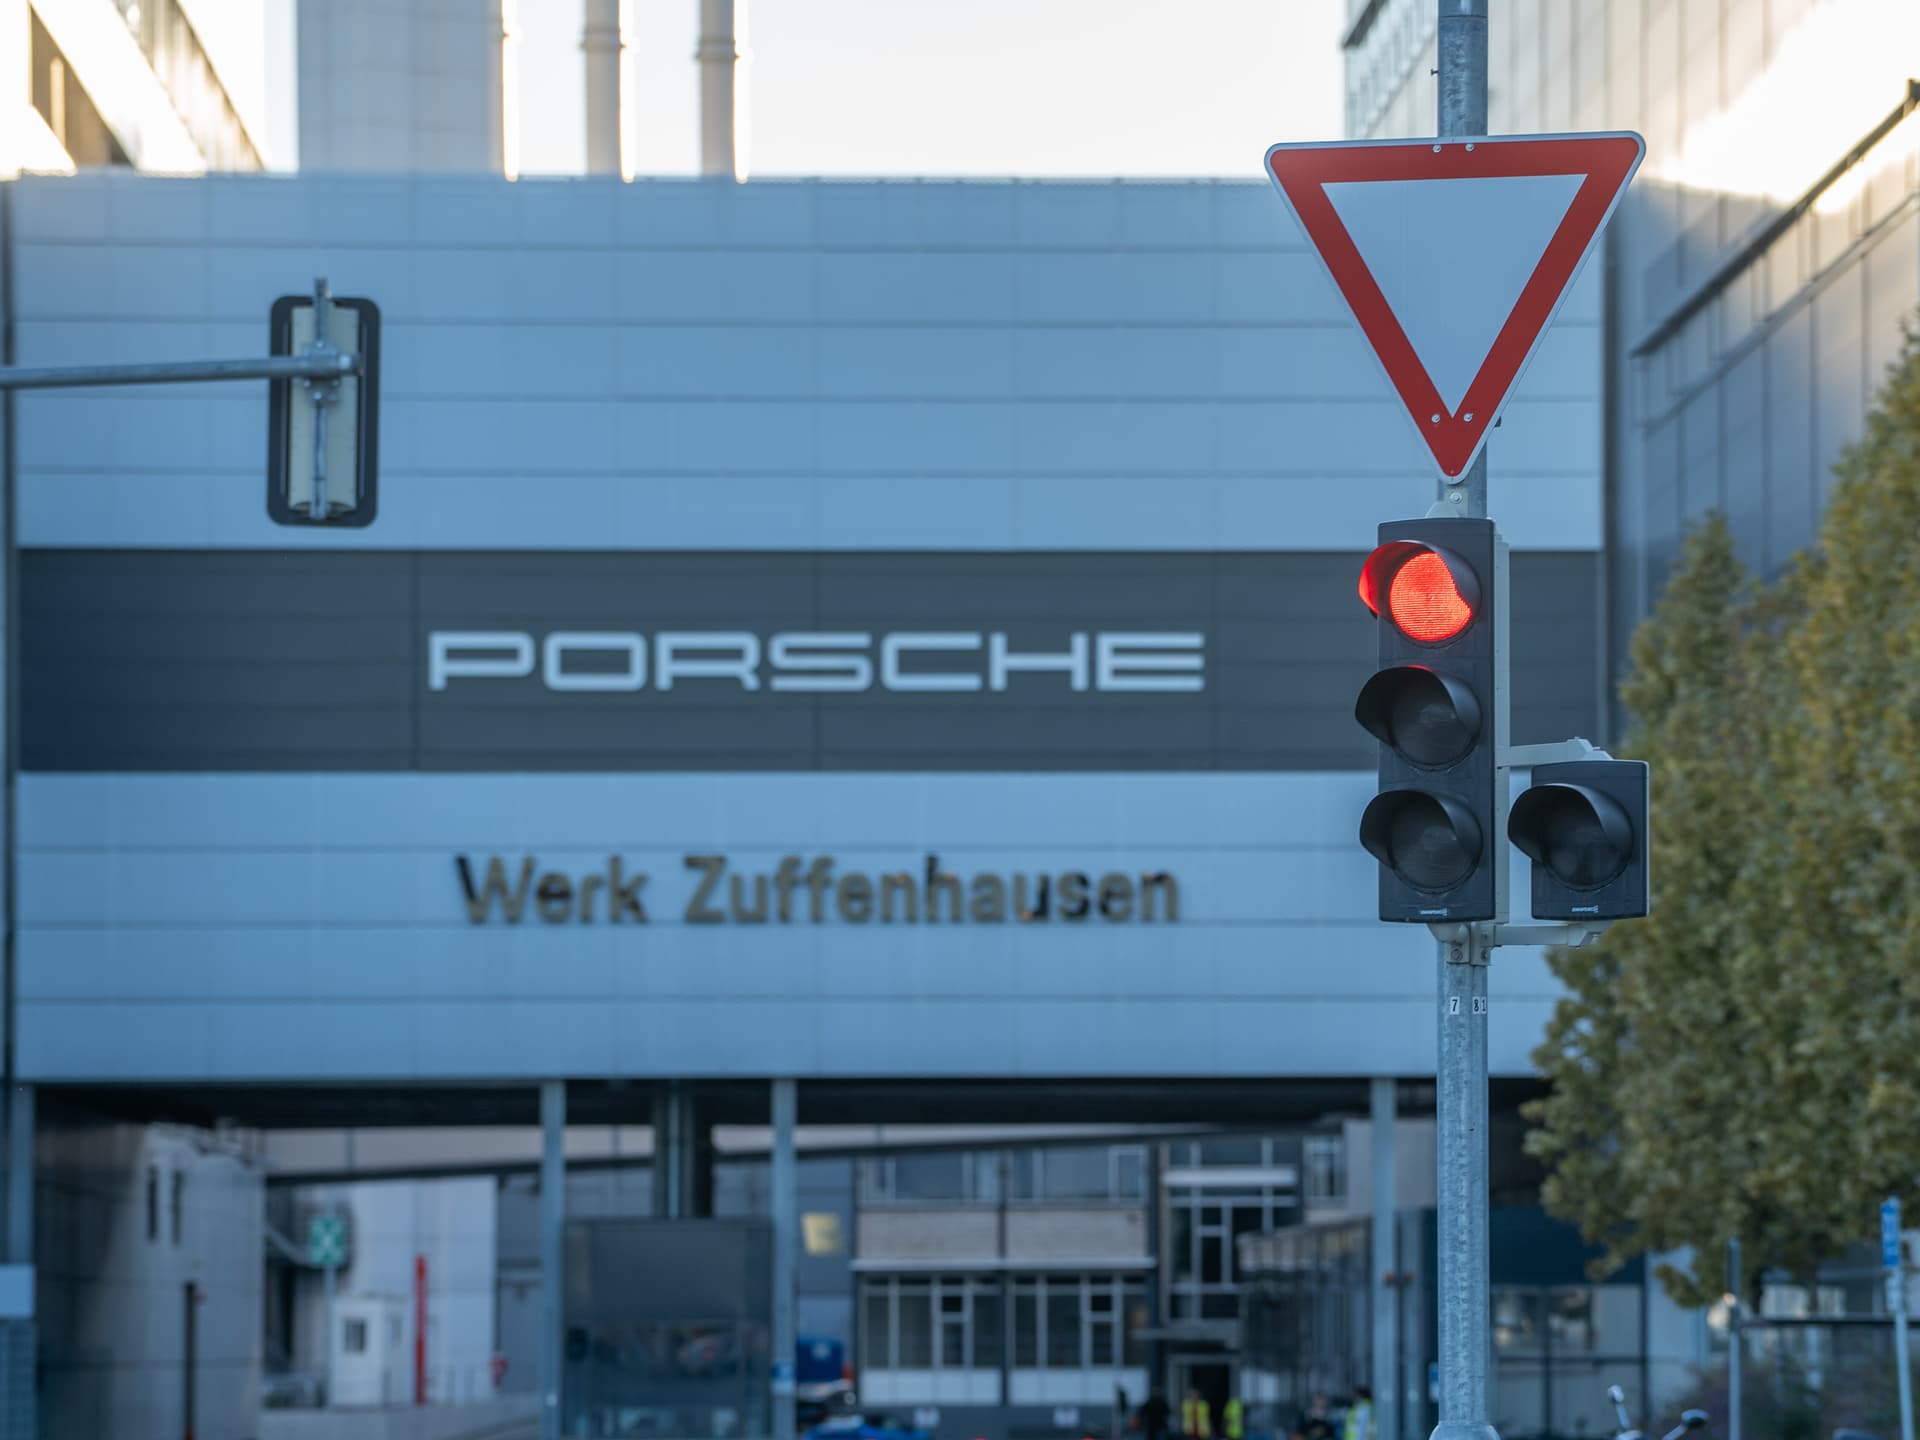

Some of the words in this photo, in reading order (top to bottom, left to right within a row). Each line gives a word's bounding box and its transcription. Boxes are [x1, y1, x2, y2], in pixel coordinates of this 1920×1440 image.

[428, 631, 1206, 692] PORSCHE
[455, 854, 649, 925] Werk
[683, 854, 1180, 924] Zuffenhausen
